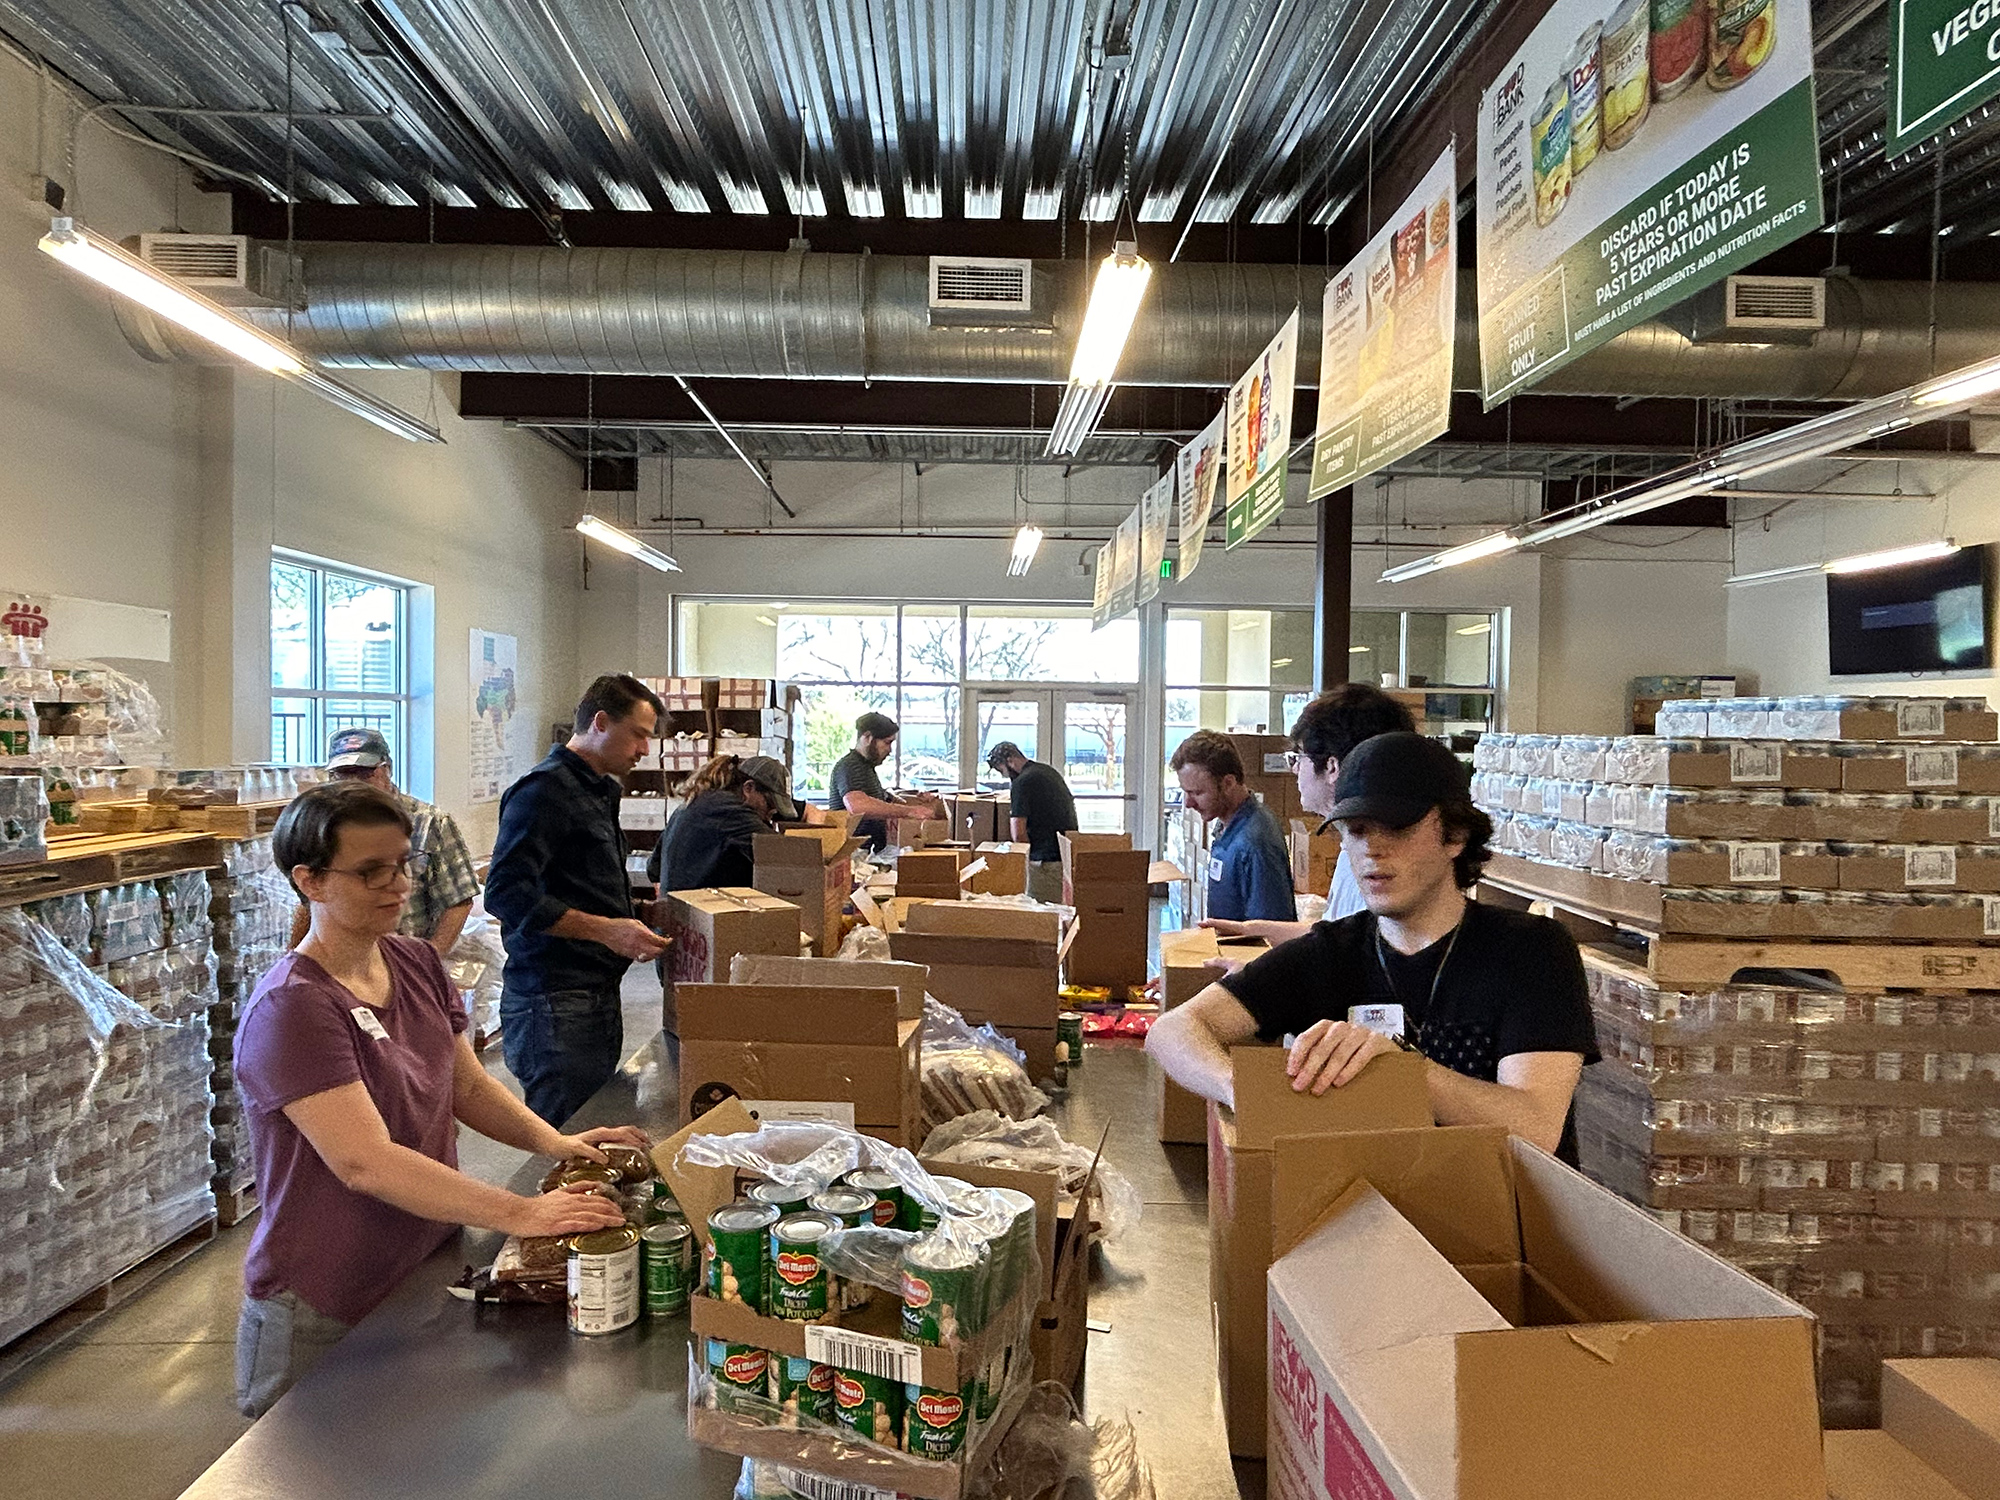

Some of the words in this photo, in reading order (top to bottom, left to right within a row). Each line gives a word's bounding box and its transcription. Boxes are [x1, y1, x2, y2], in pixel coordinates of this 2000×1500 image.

[1614, 43, 1642, 74] PEARS
[1497, 88, 1525, 128] BANK
[1499, 147, 1518, 171] Pears
[1600, 206, 1657, 258] DISCARD
[1659, 193, 1674, 219] IF
[1675, 155, 1729, 206] TODAY
[1733, 142, 1750, 171] IS
[1610, 254, 1619, 274] 5
[1620, 224, 1666, 268] YEARS
[1667, 210, 1688, 237] OR
[1691, 175, 1741, 222] MORE
[1596, 271, 1629, 307] PAST
[1630, 222, 1717, 287] EXPIRATION
[1721, 185, 1768, 231] DATE
[1574, 322, 1595, 342] MUST
[1593, 311, 1612, 333] HAVE
[1609, 308, 1617, 322] A
[1617, 298, 1632, 318] LIST
[1633, 292, 1645, 308] OF
[1644, 262, 1696, 301] INGREDIENTS
[1697, 251, 1718, 271] AND
[1717, 221, 1771, 259] NUTRITION
[1771, 200, 1807, 229] FACTS
[1508, 322, 1537, 355] FRUIT
[1511, 347, 1536, 377] ONLY
[790, 1261, 817, 1273] Monte
[783, 1298, 808, 1308] DICED
[785, 1308, 824, 1320] POTATOES
[727, 1362, 742, 1373] Del
[920, 1401, 933, 1414] Del
[933, 1404, 961, 1415] Monte
[925, 1440, 952, 1453] DICED
[939, 1431, 957, 1442] Cut
